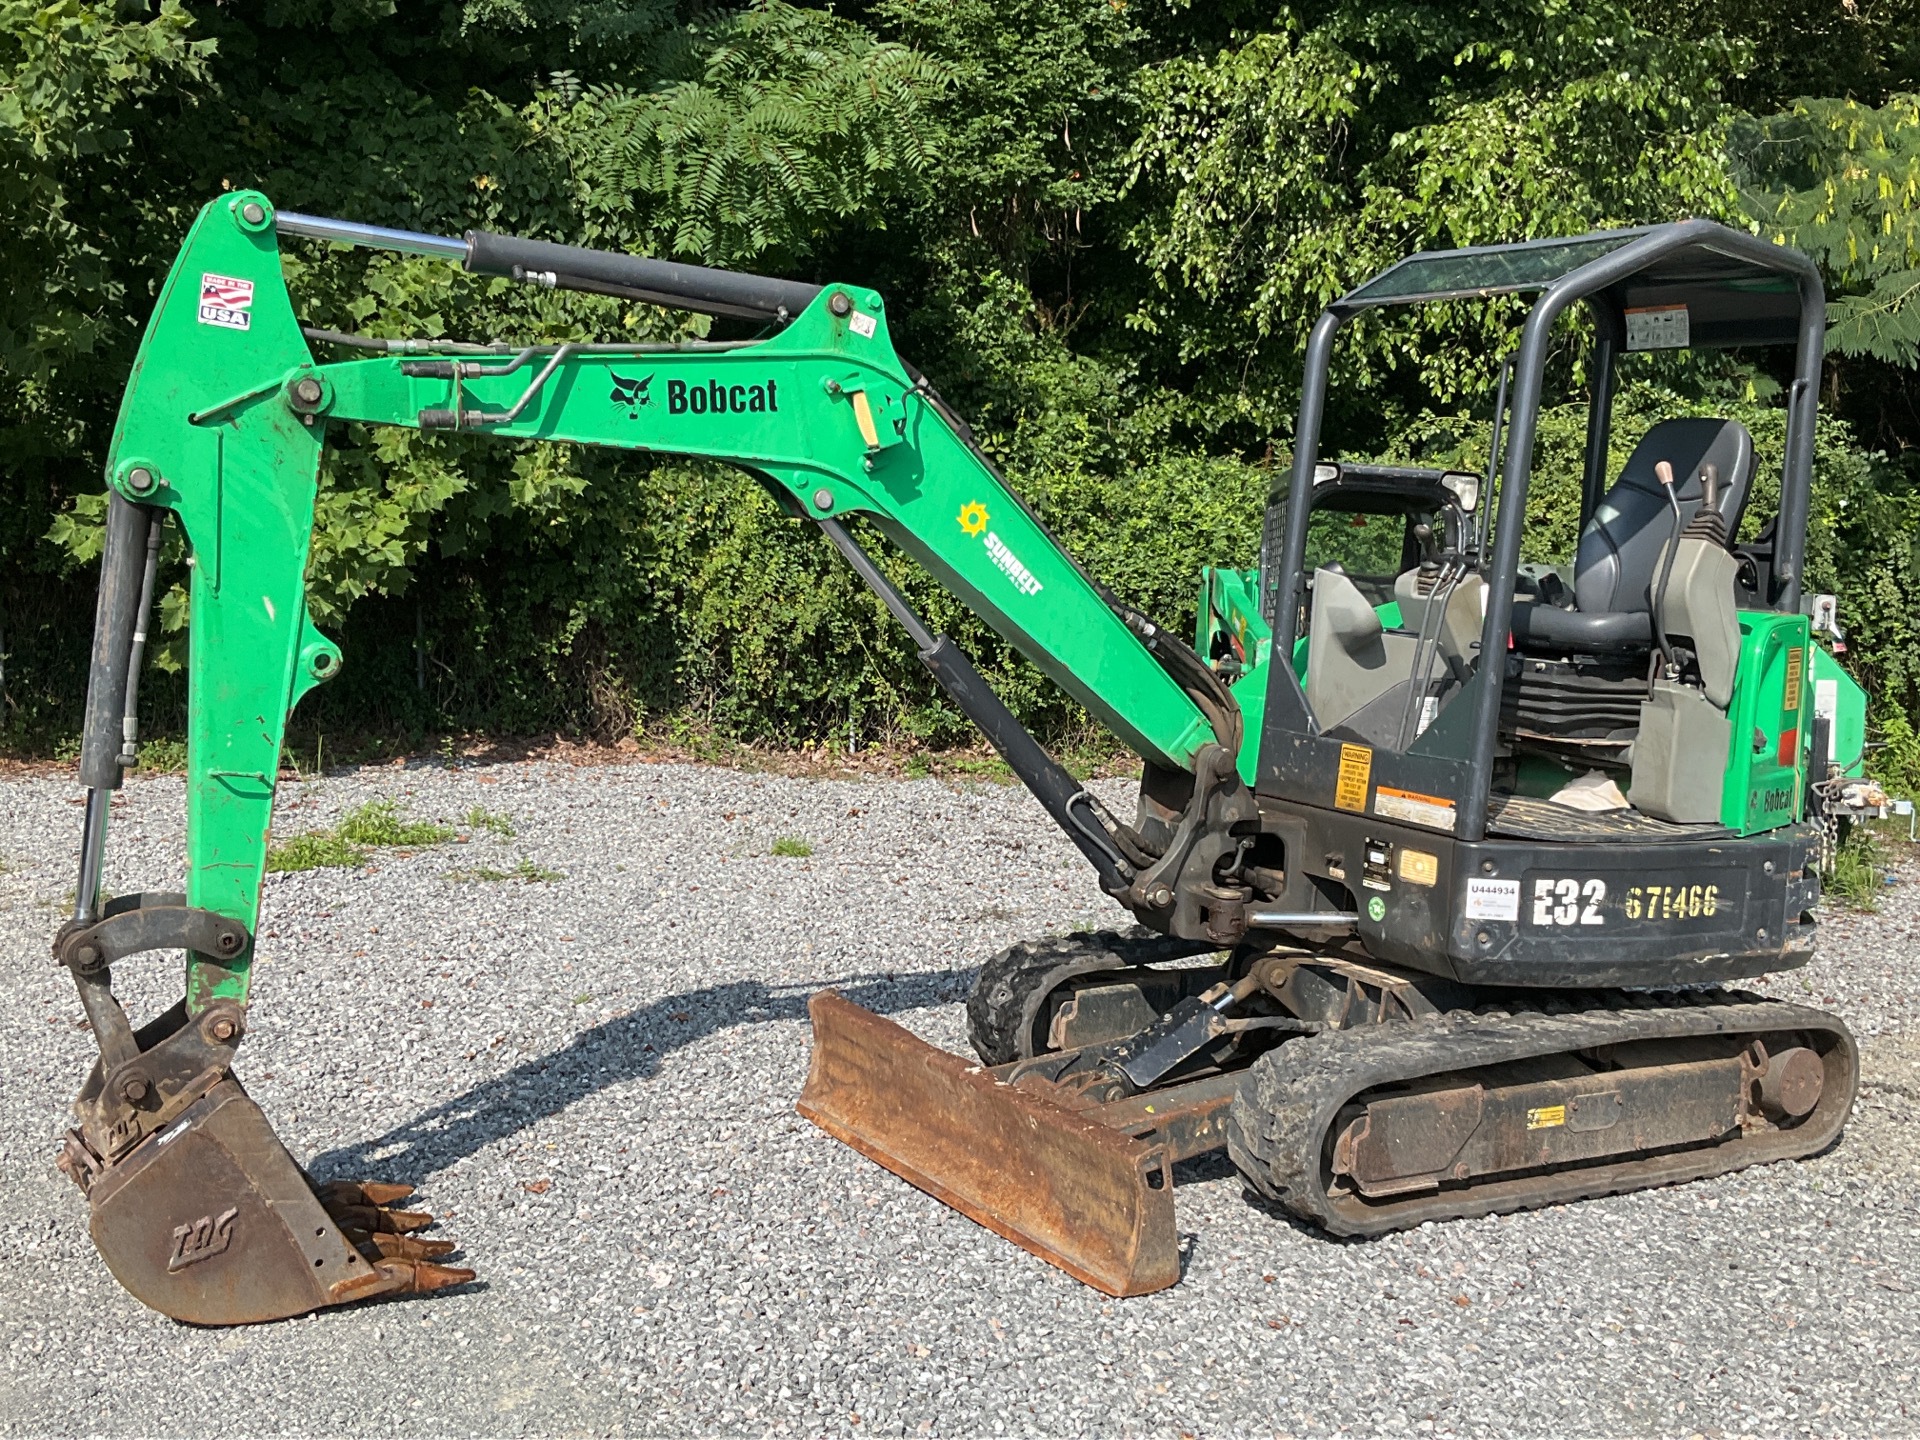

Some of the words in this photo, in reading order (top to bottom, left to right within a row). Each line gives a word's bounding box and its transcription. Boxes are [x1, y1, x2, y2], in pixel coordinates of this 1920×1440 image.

[206, 276, 226, 286] MADE
[202, 306, 246, 325] USA
[667, 378, 778, 415] Bobcat
[983, 531, 1044, 597] SUNBELT
[986, 550, 1027, 595] RENTALS
[1344, 750, 1369, 762] WARNING
[1764, 785, 1793, 813] Bobcat
[1471, 885, 1515, 895] U444934
[1533, 879, 1606, 926] E32
